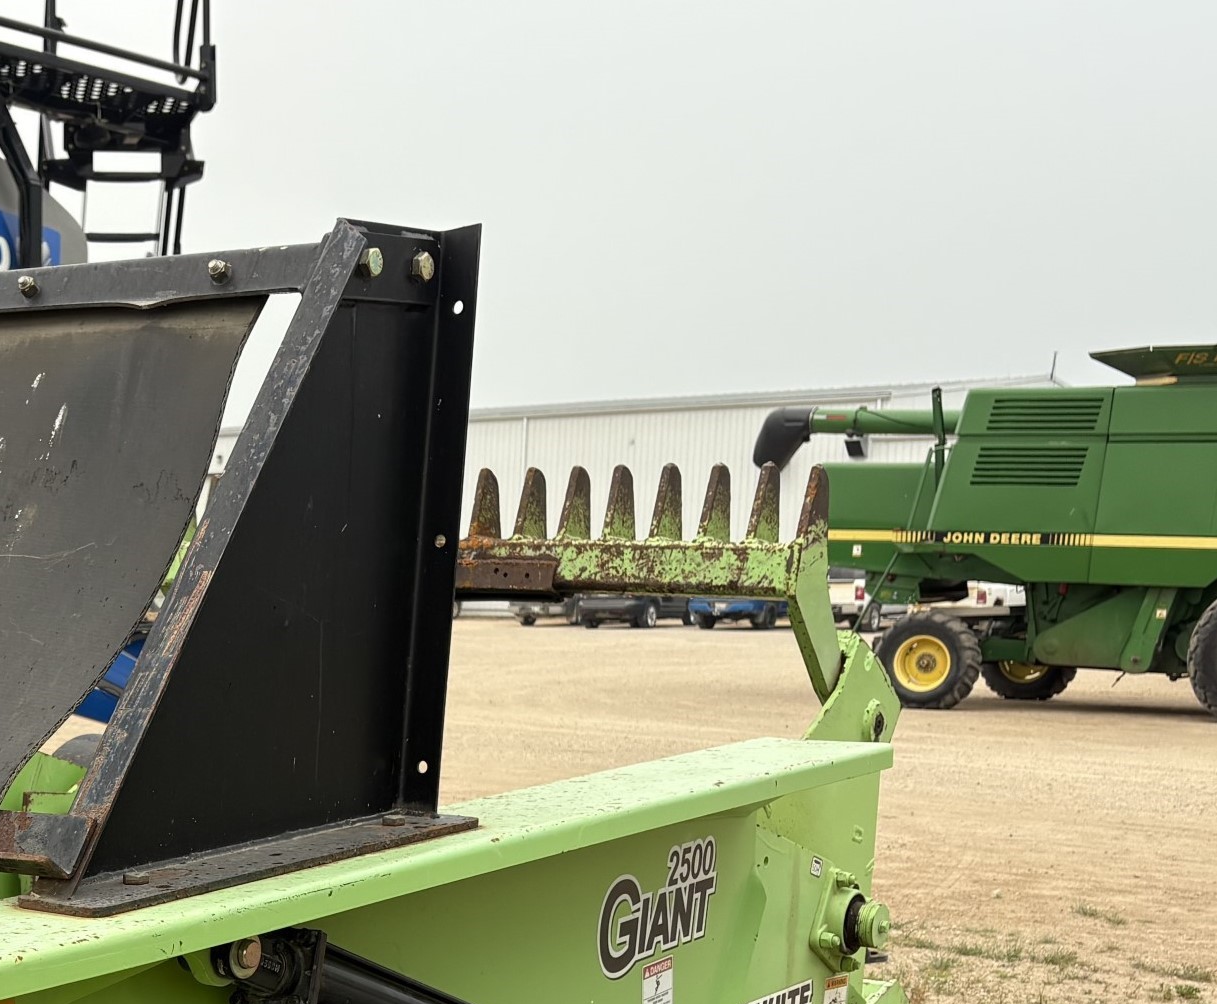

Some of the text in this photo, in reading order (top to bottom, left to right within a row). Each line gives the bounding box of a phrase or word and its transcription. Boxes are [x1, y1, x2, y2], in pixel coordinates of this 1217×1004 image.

[942, 531, 1041, 546] JOHN DEERE
[668, 839, 715, 887] 2500
[599, 876, 716, 974] GIANT
[649, 959, 672, 975] DANGER
